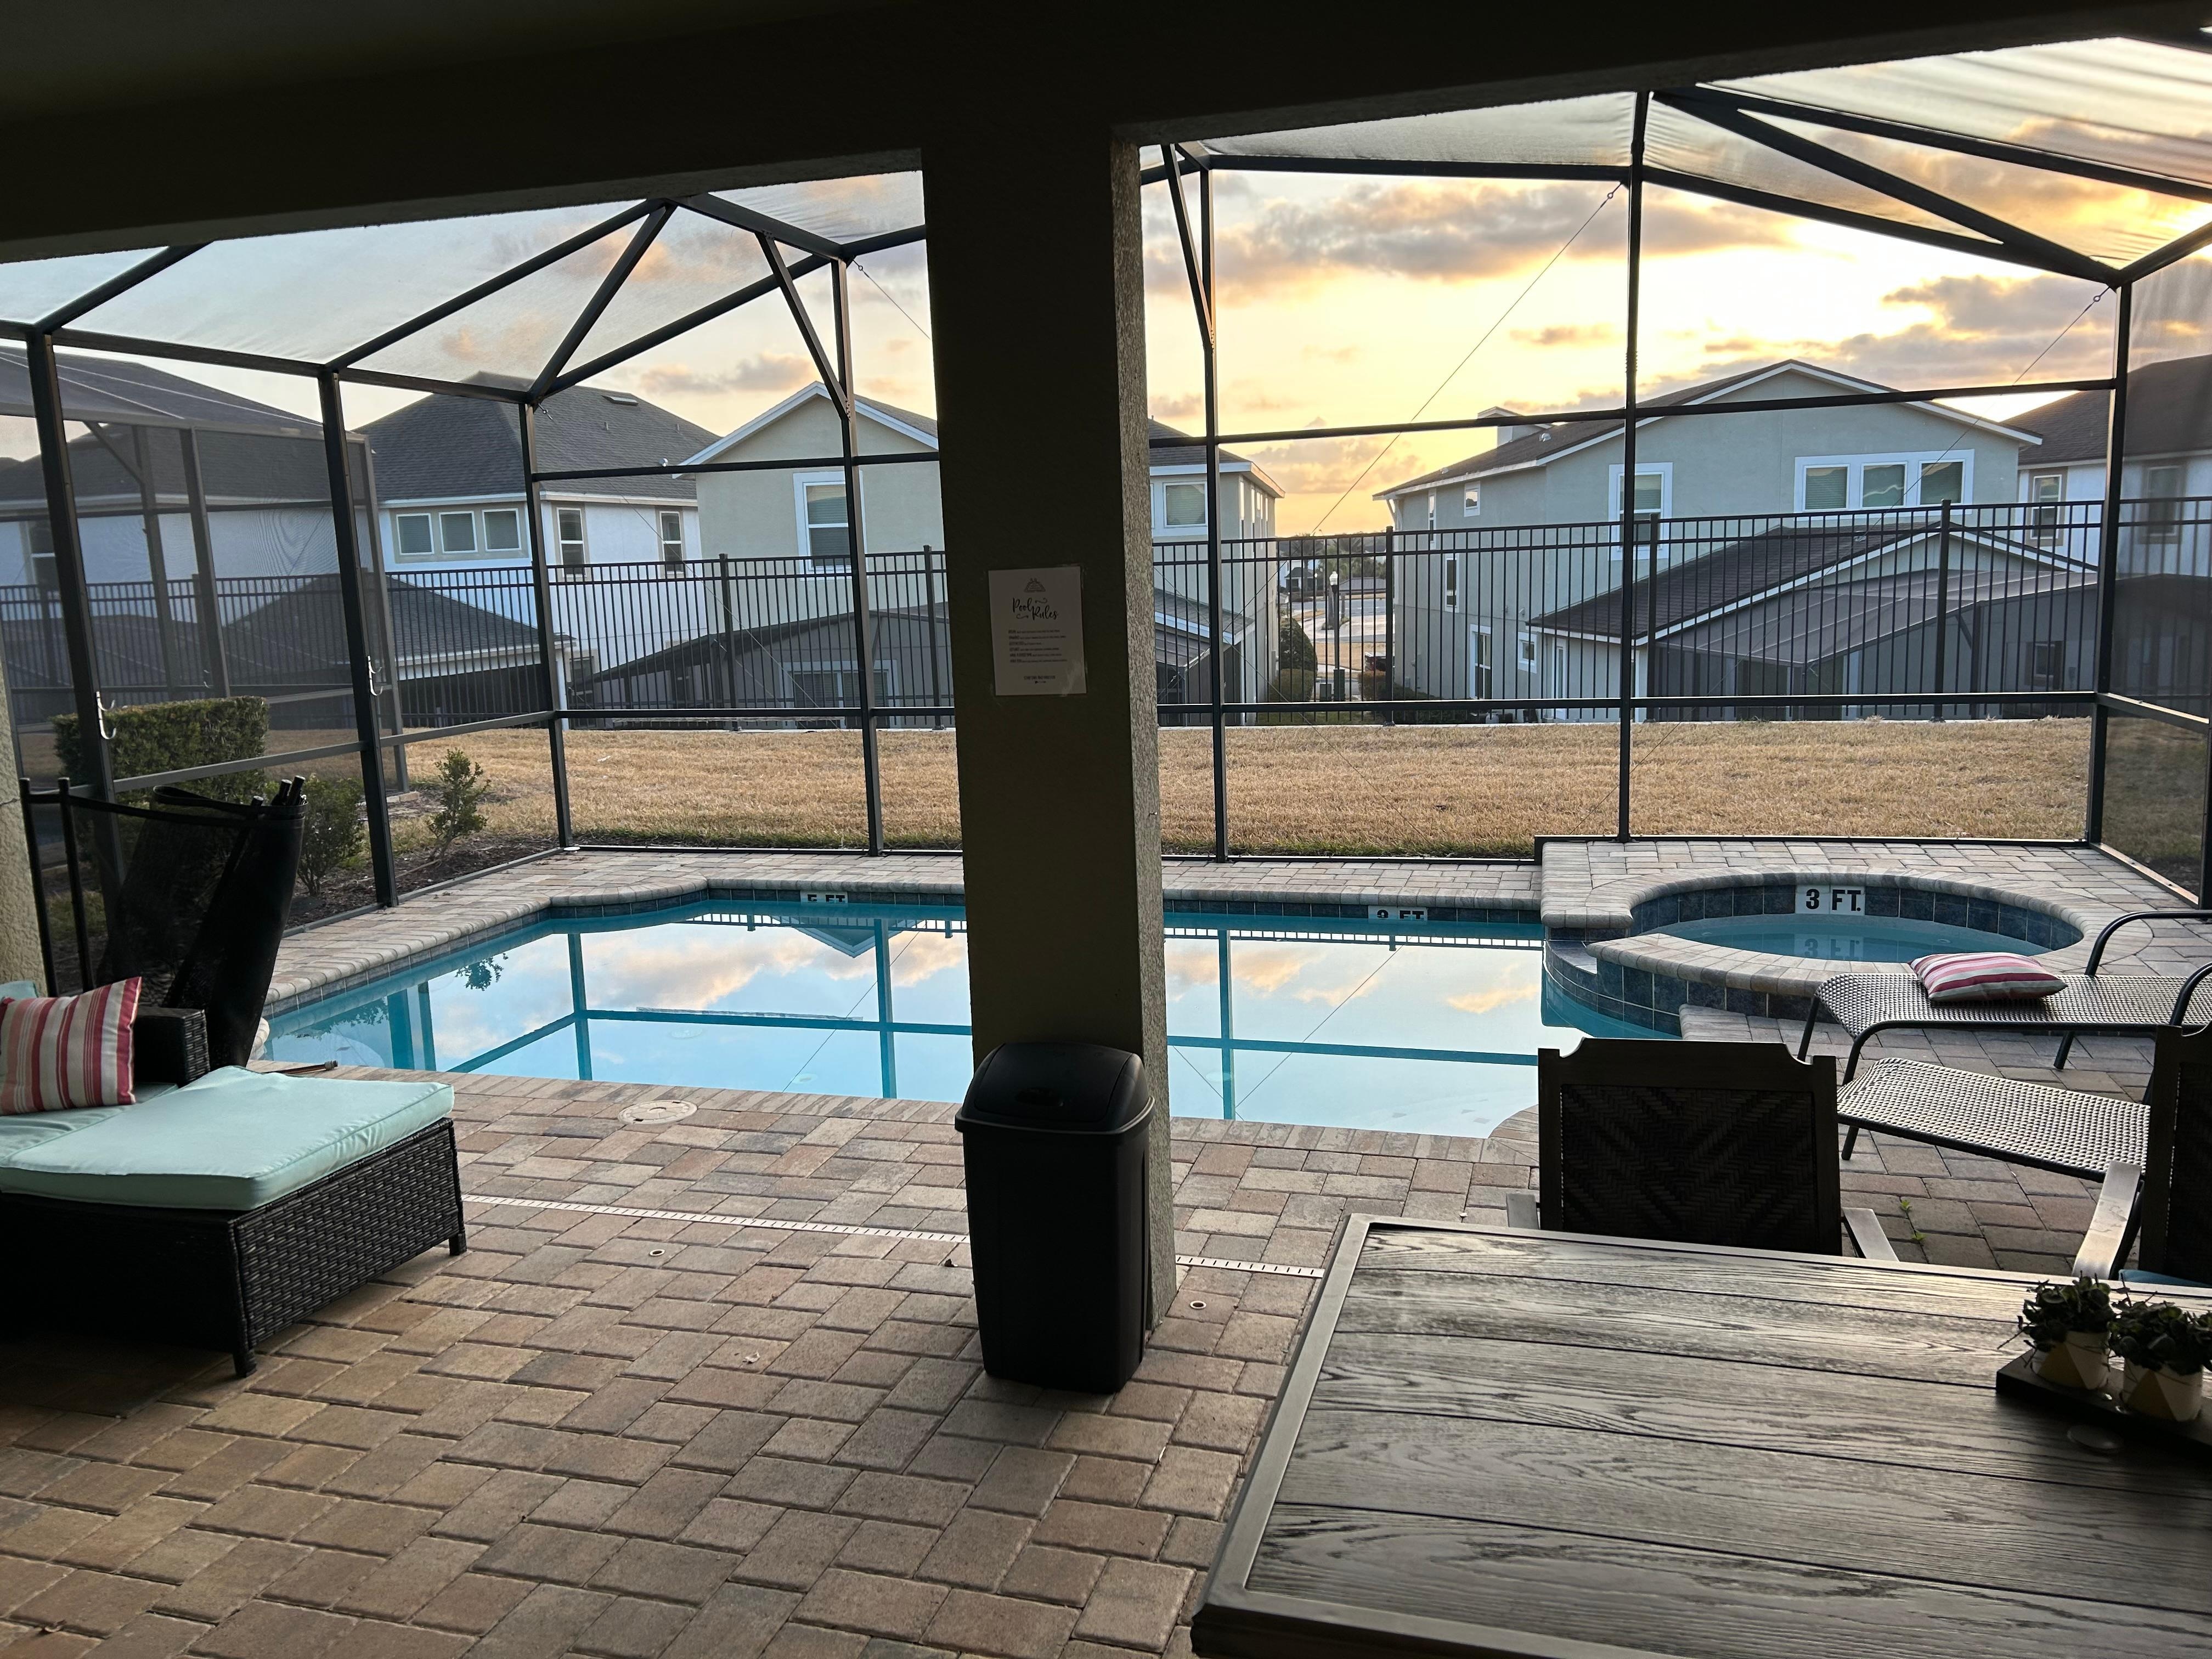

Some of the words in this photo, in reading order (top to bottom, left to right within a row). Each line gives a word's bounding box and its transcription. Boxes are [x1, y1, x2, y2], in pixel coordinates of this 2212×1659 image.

[1012, 597, 1032, 613] Pool
[1031, 605, 1058, 620] Rules
[1805, 889, 1820, 909] 3
